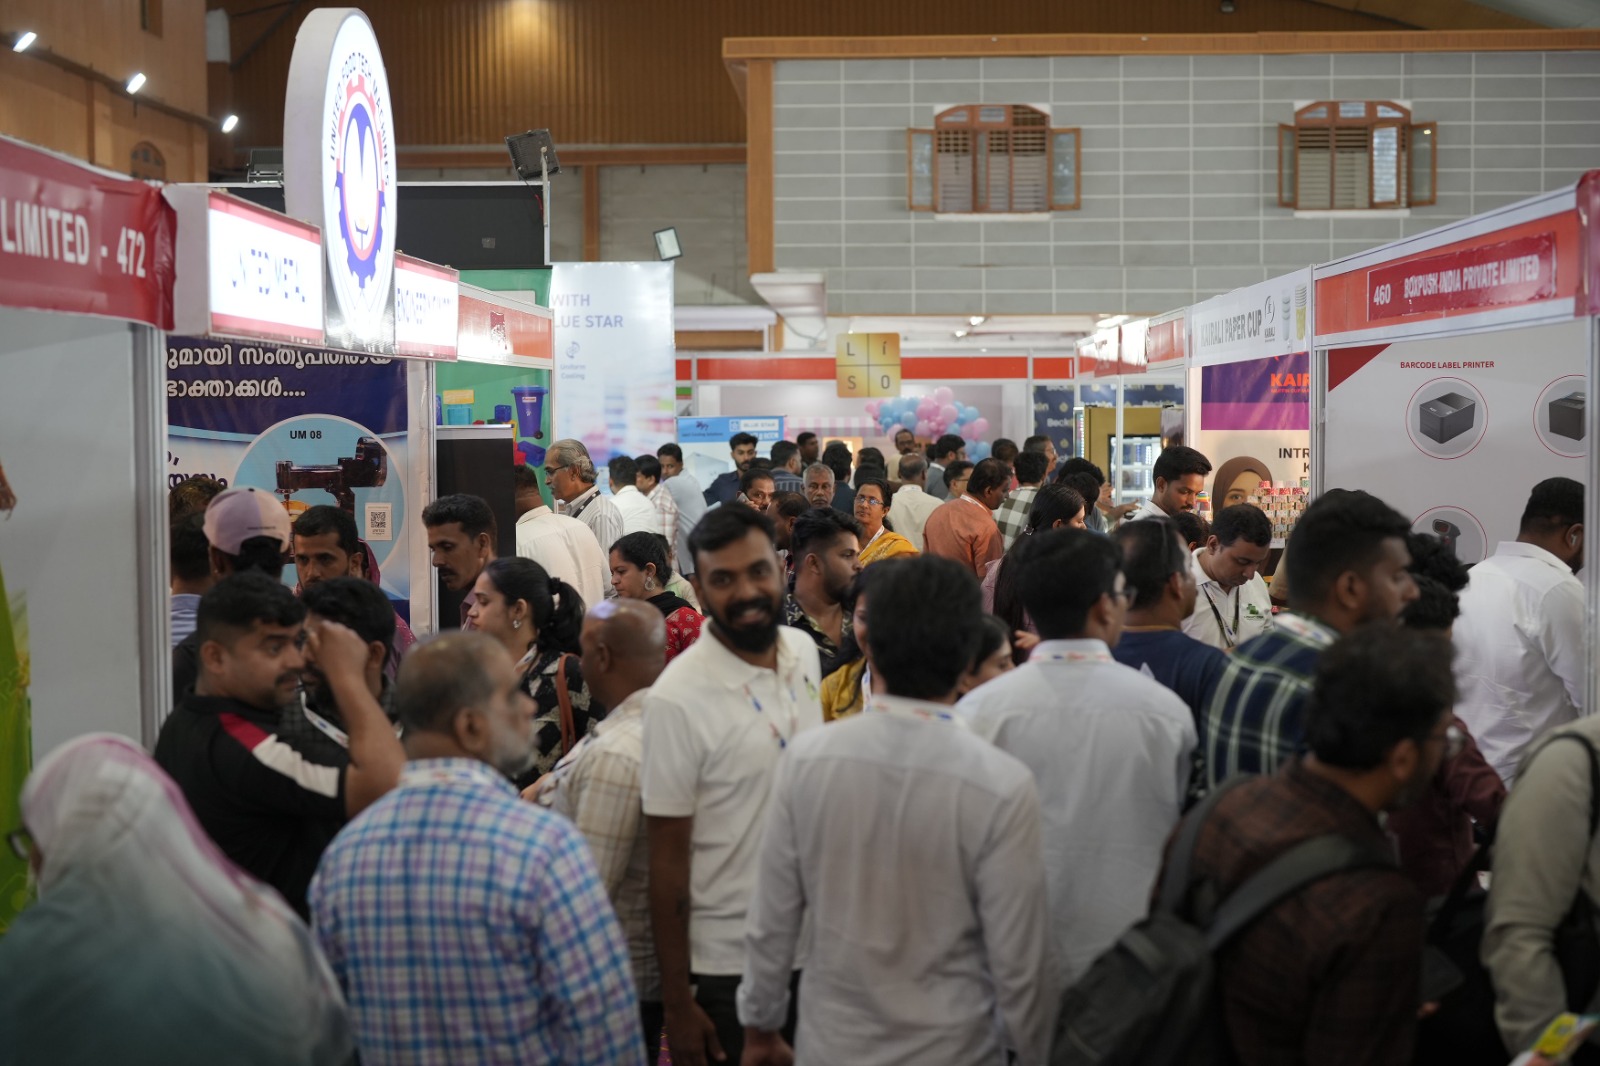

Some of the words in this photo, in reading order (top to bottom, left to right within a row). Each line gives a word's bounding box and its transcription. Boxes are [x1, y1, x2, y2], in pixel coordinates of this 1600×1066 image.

[1, 198, 90, 266] LIMITED
[117, 226, 146, 278] 472
[1373, 283, 1391, 305] 460
[1403, 271, 1438, 299] BOXPUSH
[1439, 267, 1461, 294] INDIA
[1463, 261, 1499, 291] PRIVATE
[1501, 253, 1540, 285] LIMITED
[551, 294, 590, 306] WITH
[585, 315, 624, 328] STAR
[1200, 319, 1224, 347] KAIRALI
[1225, 313, 1245, 342] PAPER
[1247, 309, 1262, 338] CUP
[1400, 361, 1436, 369] BARCODE
[1437, 361, 1461, 369] LABEL
[1462, 361, 1495, 369] PRINTER
[289, 430, 307, 440] UM
[309, 430, 322, 440] 08
